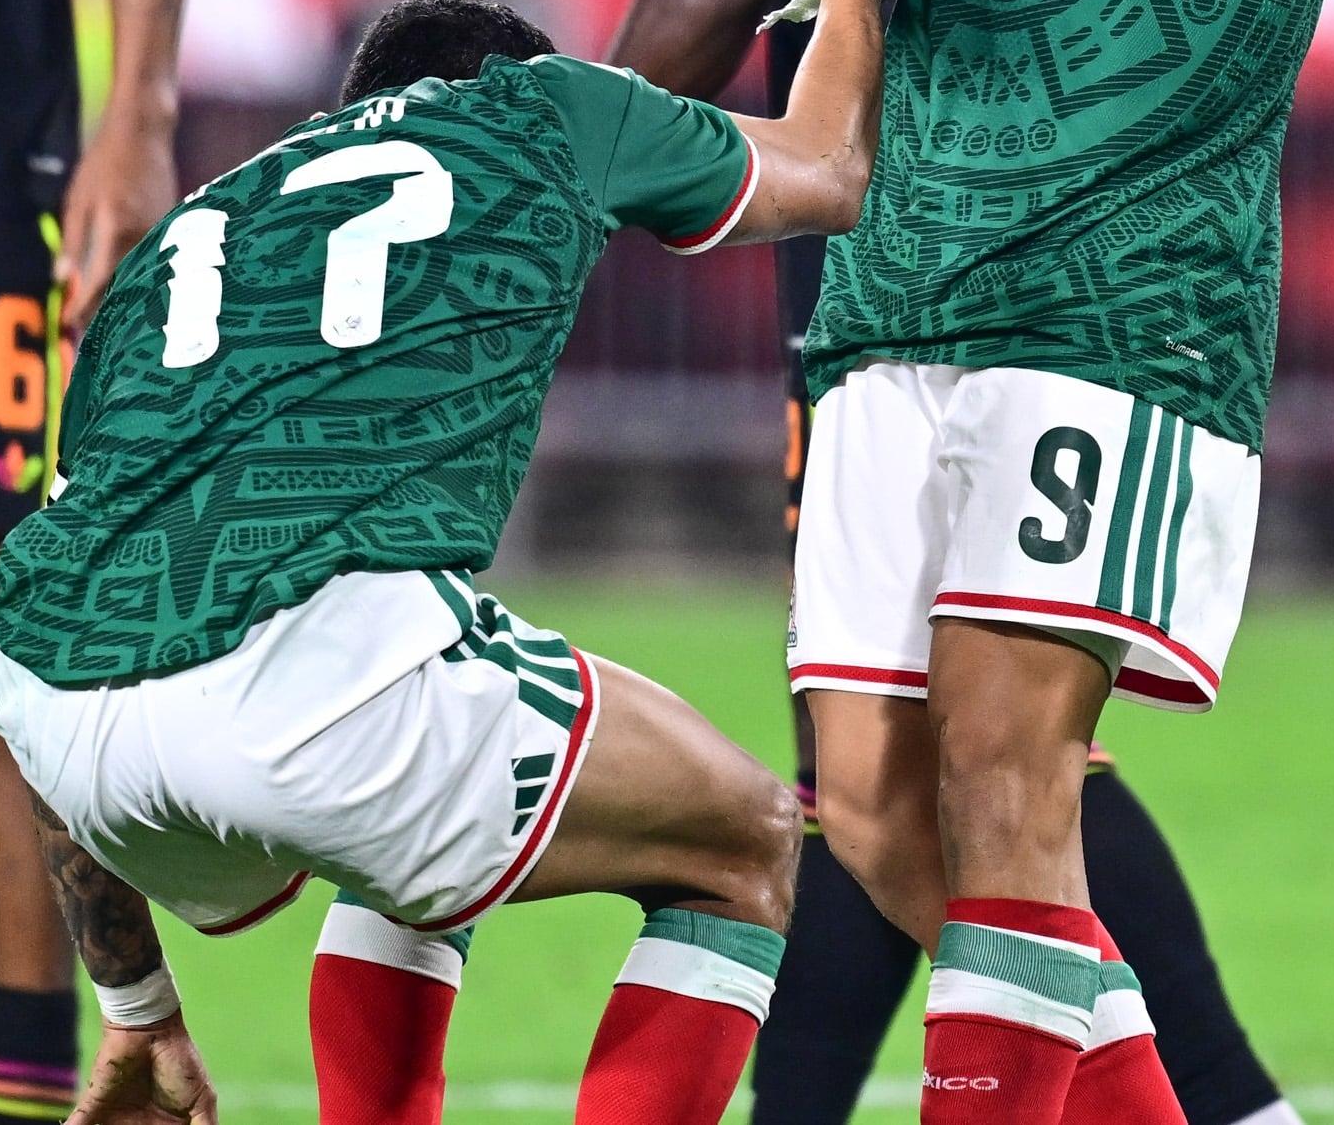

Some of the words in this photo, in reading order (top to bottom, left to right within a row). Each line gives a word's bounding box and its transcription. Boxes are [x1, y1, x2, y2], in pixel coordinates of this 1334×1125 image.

[159, 140, 454, 368] 17
[1018, 426, 1102, 564] 9
[923, 1067, 999, 1091] XICO
